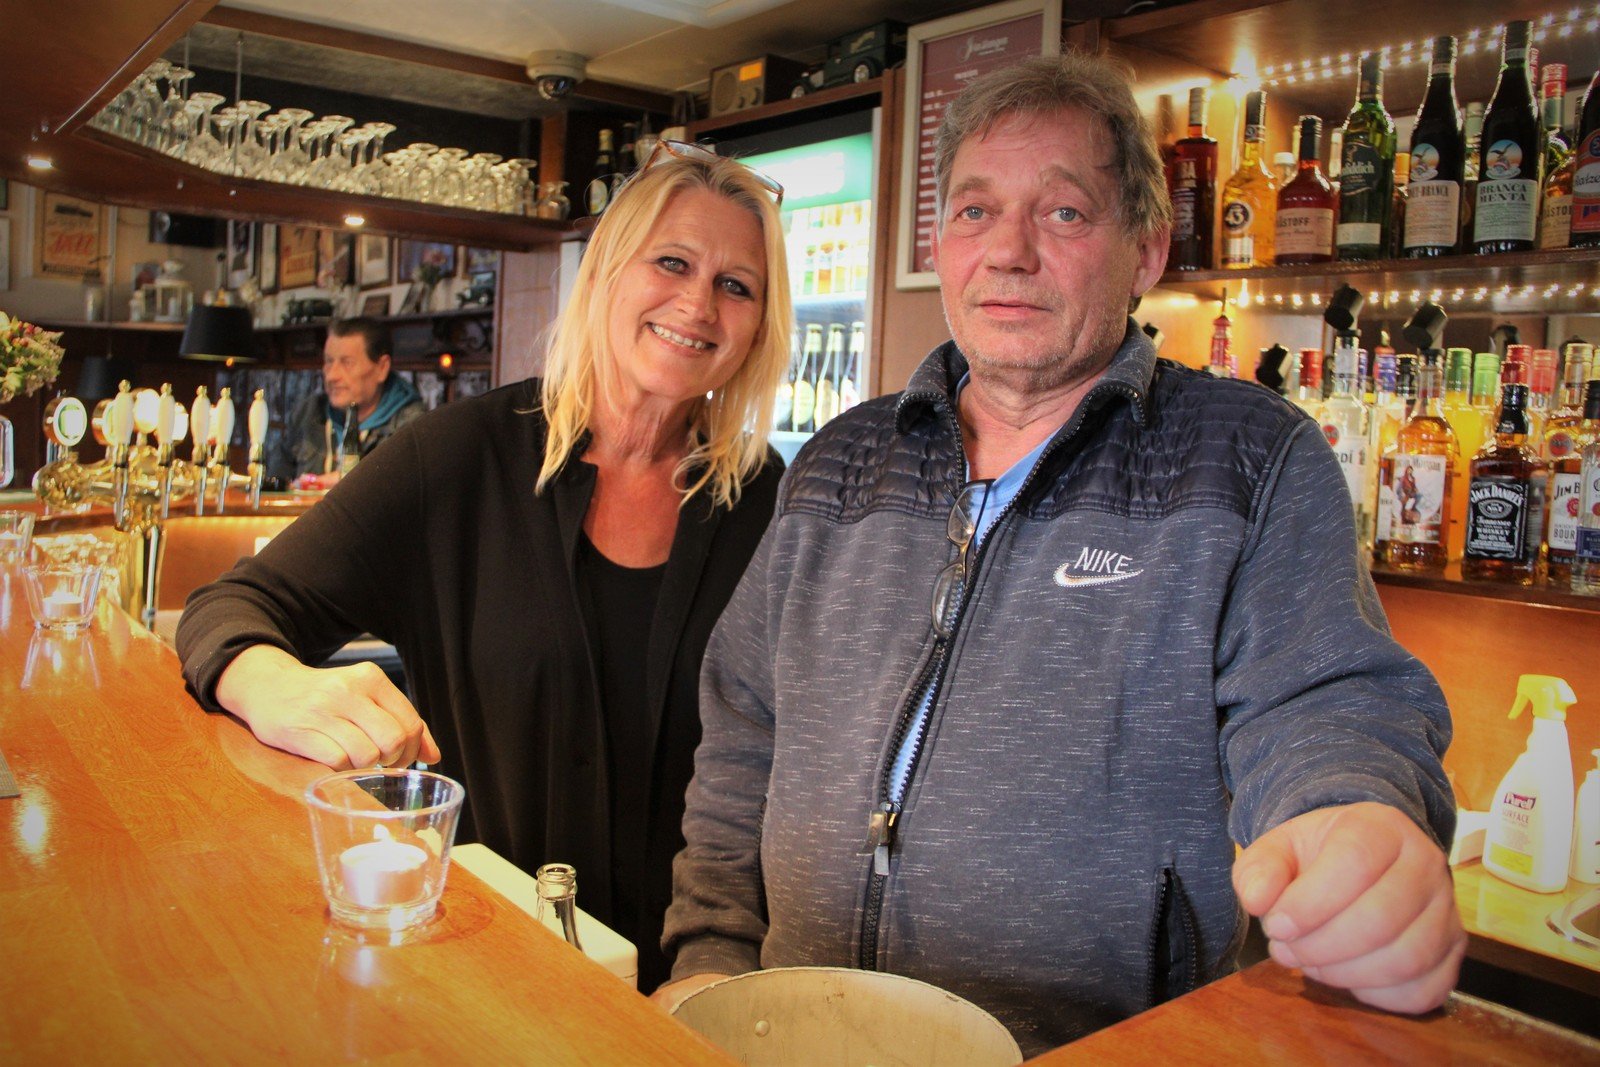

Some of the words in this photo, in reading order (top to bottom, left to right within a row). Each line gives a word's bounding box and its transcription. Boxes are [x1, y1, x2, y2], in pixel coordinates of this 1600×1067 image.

[1480, 183, 1527, 194] BRANCA
[1470, 487, 1491, 503] JACK
[1554, 485, 1572, 500] JIM
[1074, 546, 1133, 574] NIKE
